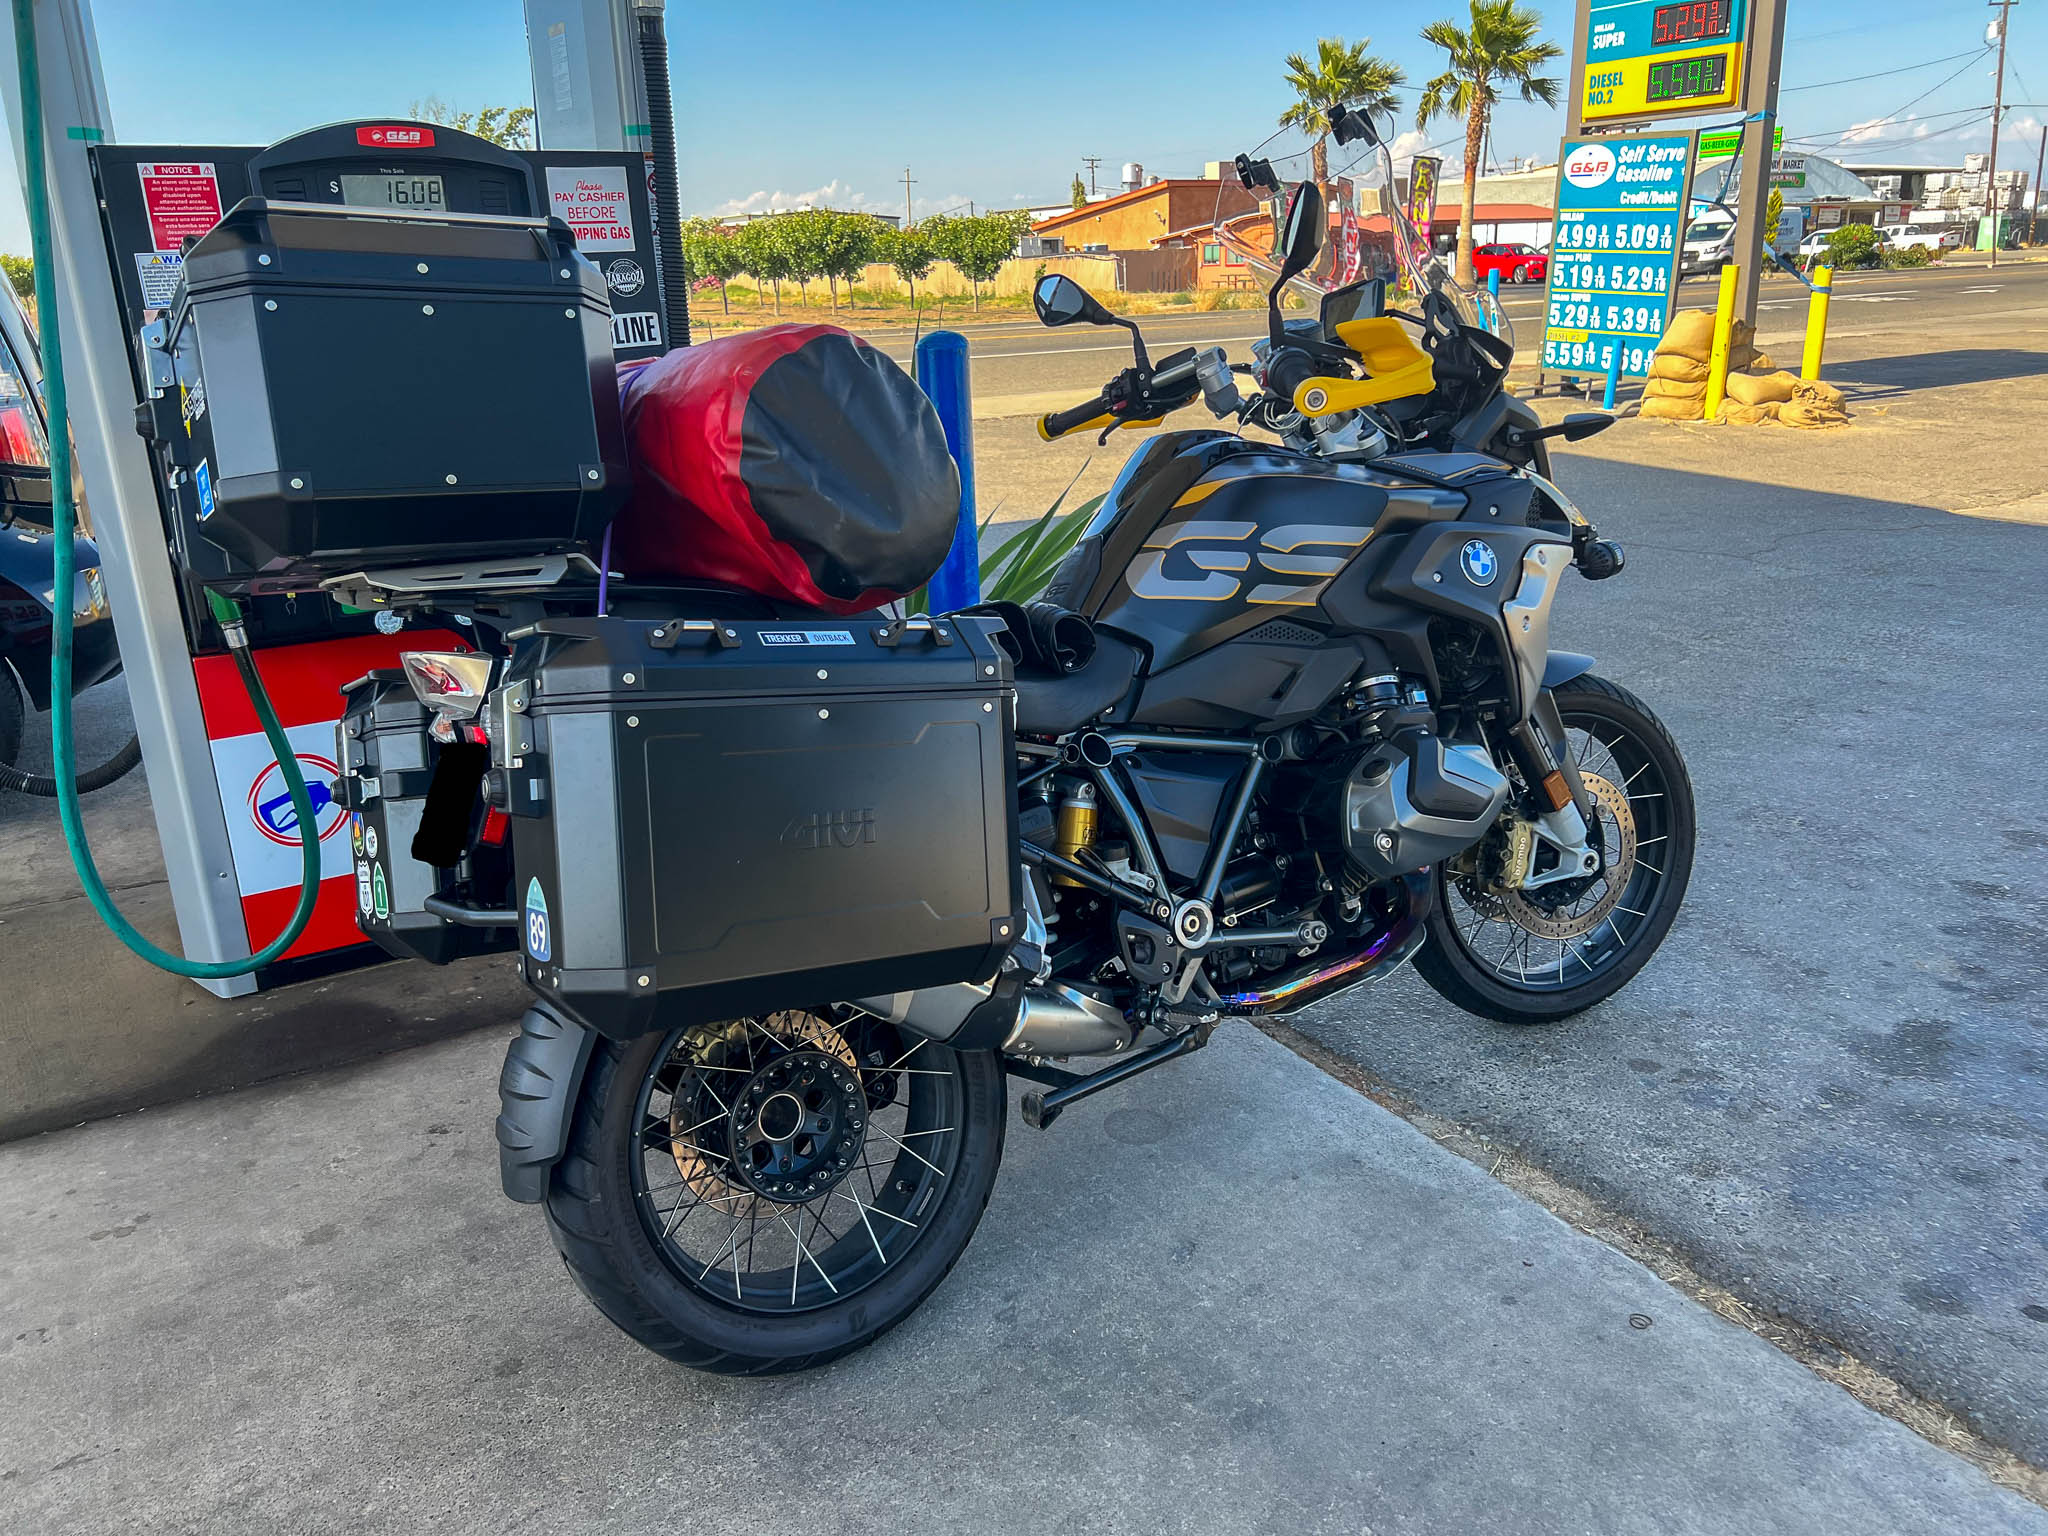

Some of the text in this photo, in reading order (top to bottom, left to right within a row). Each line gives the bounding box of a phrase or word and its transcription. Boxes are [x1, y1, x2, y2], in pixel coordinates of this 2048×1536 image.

[1656, 3, 1707, 42] 5.29
[1593, 31, 1625, 50] SUPER
[1590, 72, 1624, 90] DIESEL
[1651, 61, 1702, 98] 5.59
[1588, 90, 1613, 106] NO.2
[386, 131, 421, 140] G&B
[1618, 144, 1686, 163] Self Serve
[1570, 161, 1609, 173] G&B
[1616, 164, 1673, 183] Gasoline
[1783, 160, 1804, 169] MARKET
[329, 181, 339, 193] $
[387, 180, 441, 205] 16.08
[575, 180, 603, 191] Please
[555, 192, 625, 202] PAY CASHIER
[1620, 190, 1678, 205] Credit/Debit
[567, 206, 616, 219] BEFORE
[574, 226, 631, 240] MPING GAS
[1557, 224, 1597, 248] 4.99
[1615, 224, 1659, 248] 5.09
[162, 256, 182, 264] WA
[606, 267, 645, 288] ZARAGOZA
[1553, 263, 1593, 288] 5.19
[1611, 266, 1653, 291] 5.29
[1549, 303, 1589, 327] 5.29
[1606, 306, 1648, 332] 5.39
[612, 315, 657, 345] LINE
[1545, 341, 1584, 366] 5.59
[1601, 346, 1643, 372] 569
[1465, 542, 1495, 558] BMW
[1126, 520, 1374, 607] GS
[765, 634, 850, 643] TREKKER OUTBACK
[1513, 836, 1527, 876] brembo
[530, 912, 546, 953] 89
